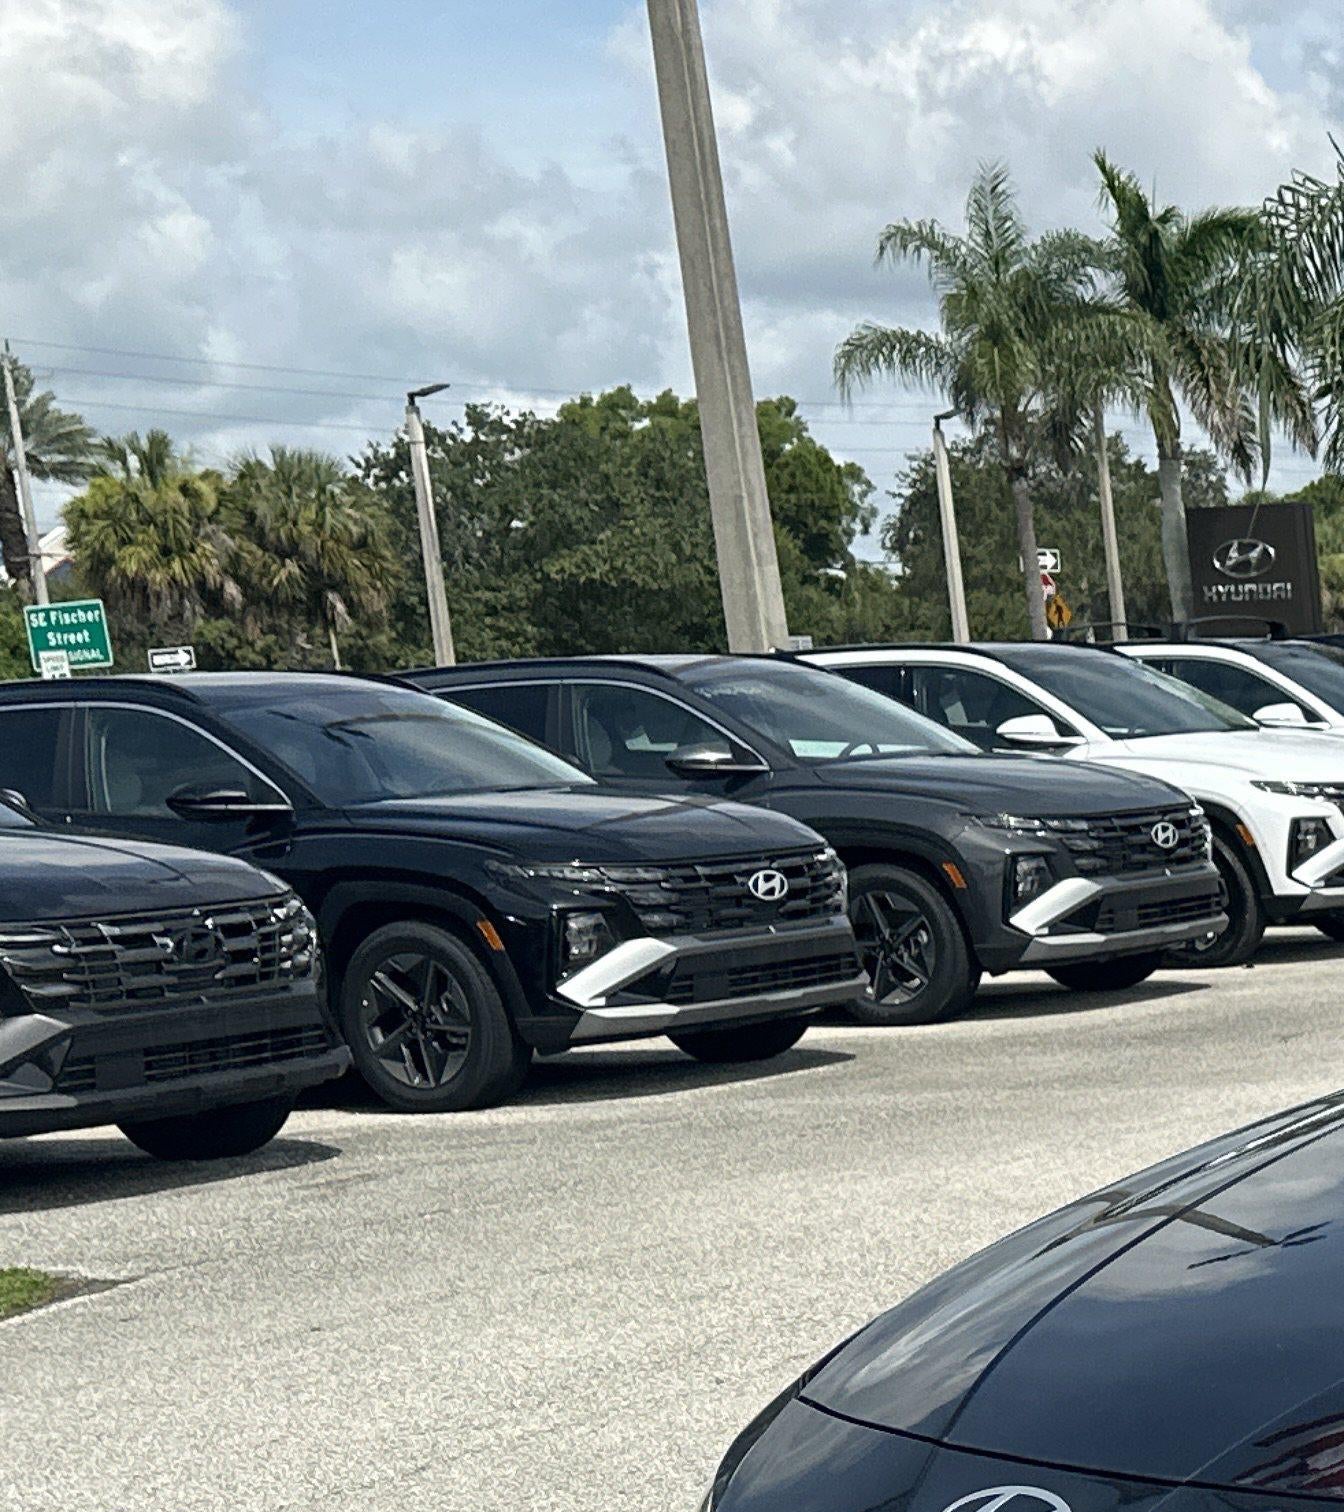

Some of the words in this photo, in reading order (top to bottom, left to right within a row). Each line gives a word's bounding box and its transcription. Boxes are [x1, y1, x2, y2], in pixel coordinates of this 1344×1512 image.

[1202, 582, 1292, 602] HYUNDAI
[29, 611, 47, 628] SE
[49, 609, 100, 626] Fischer
[46, 629, 91, 647] Street
